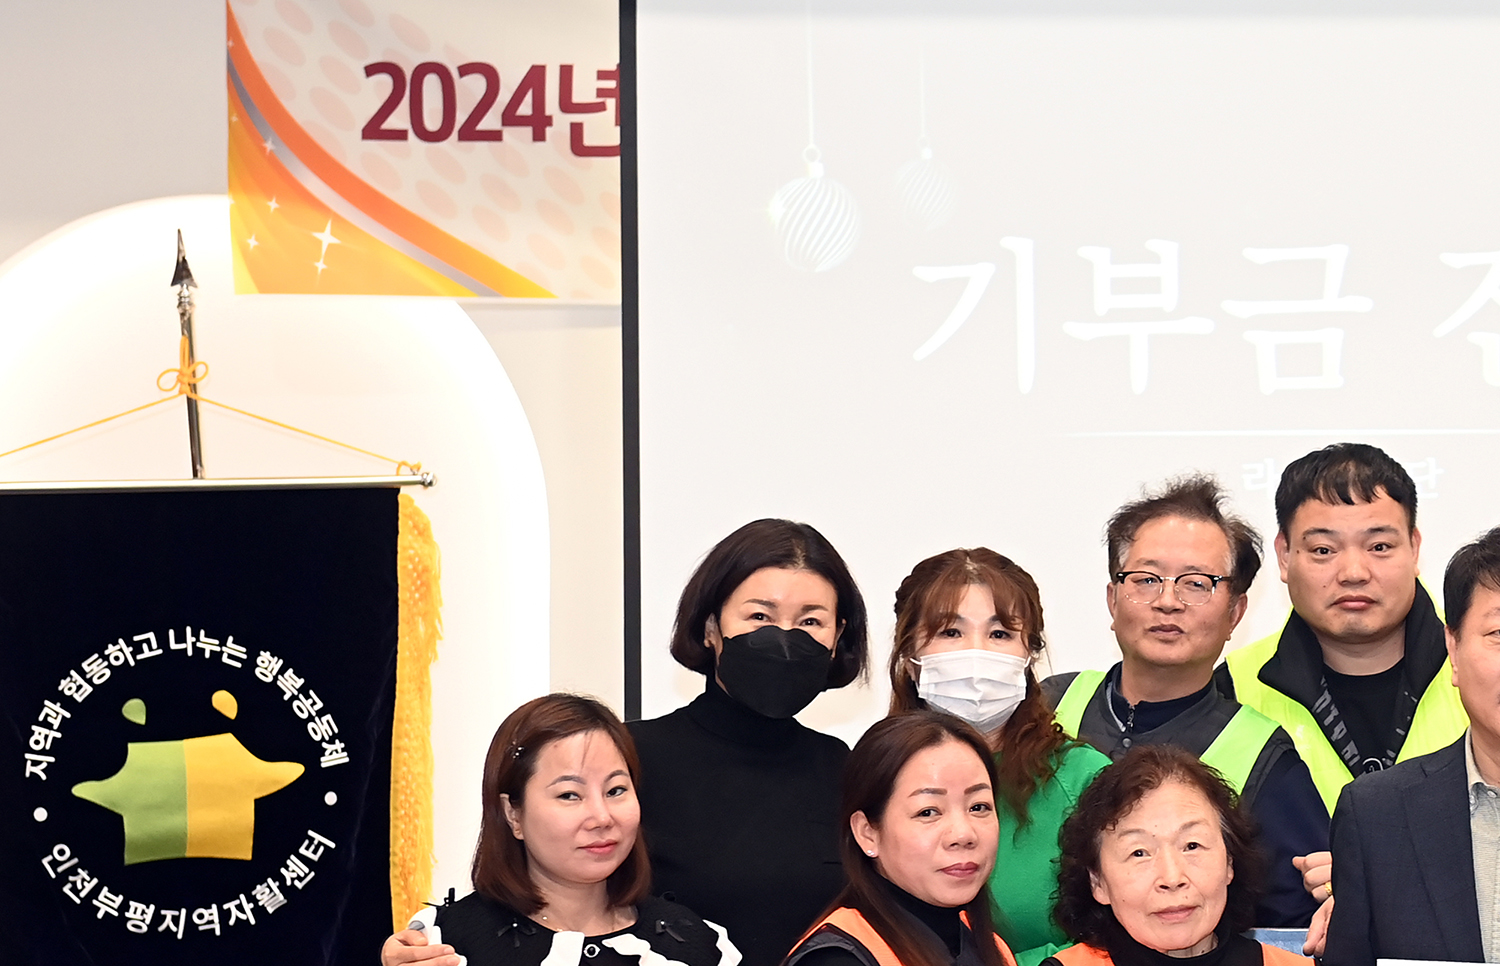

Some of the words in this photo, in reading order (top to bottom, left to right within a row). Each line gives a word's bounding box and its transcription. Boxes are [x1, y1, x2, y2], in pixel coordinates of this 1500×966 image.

[362, 62, 620, 158] 2024년
[912, 235, 1374, 395] 기부금
[25, 699, 72, 781] 지역과
[58, 631, 163, 703] 협동하고
[168, 625, 248, 669] 나누는
[254, 650, 350, 768] 행복공동체
[41, 829, 336, 940] 인천부평지역자활센터
